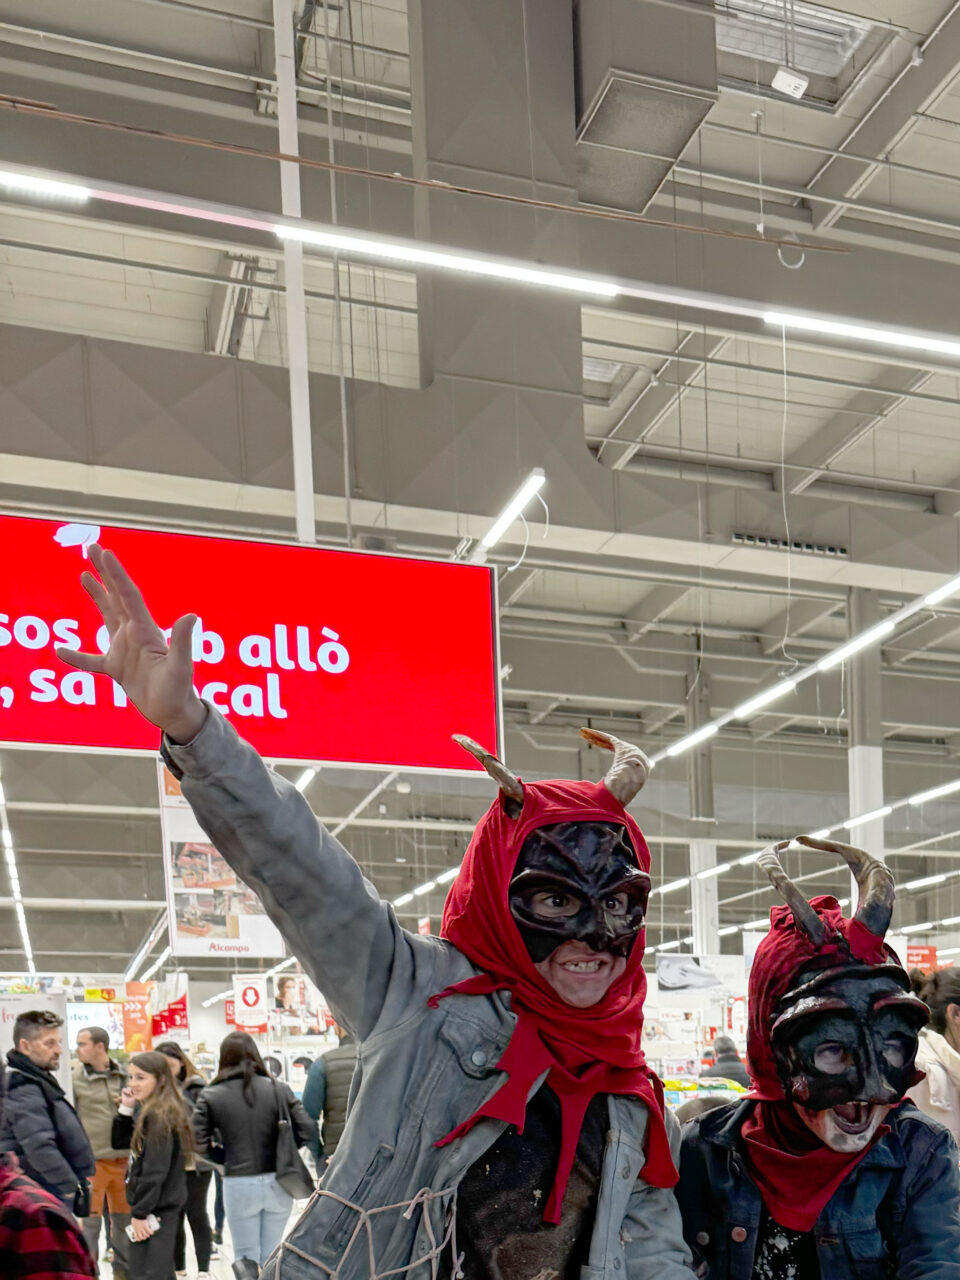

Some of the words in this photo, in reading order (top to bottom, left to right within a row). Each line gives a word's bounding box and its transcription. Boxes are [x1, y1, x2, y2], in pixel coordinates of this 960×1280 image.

[238, 623, 350, 674] allò
[29, 668, 96, 705] sa
[209, 942, 250, 952] Alcampo
